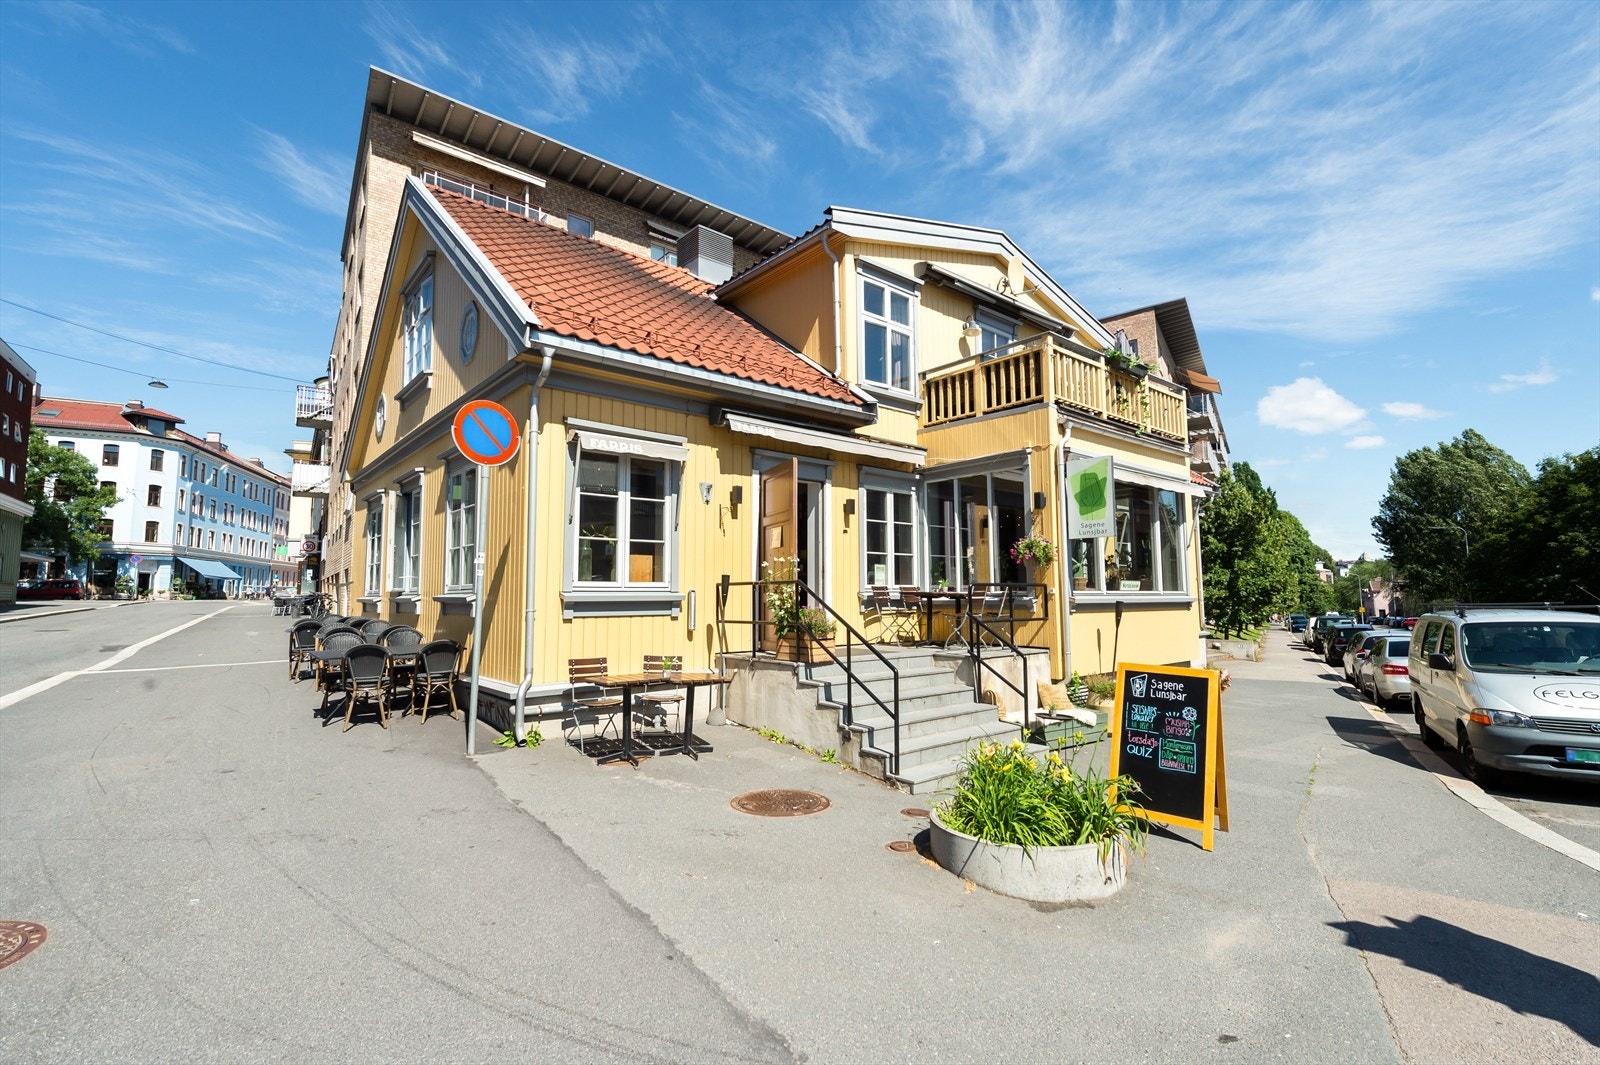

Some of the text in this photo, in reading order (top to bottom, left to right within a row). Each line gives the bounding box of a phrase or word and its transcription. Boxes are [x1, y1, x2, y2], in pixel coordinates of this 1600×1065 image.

[590, 438, 643, 454] FARRIS
[1150, 679, 1185, 692] Sagene
[1150, 689, 1188, 702] Lunsjbar
